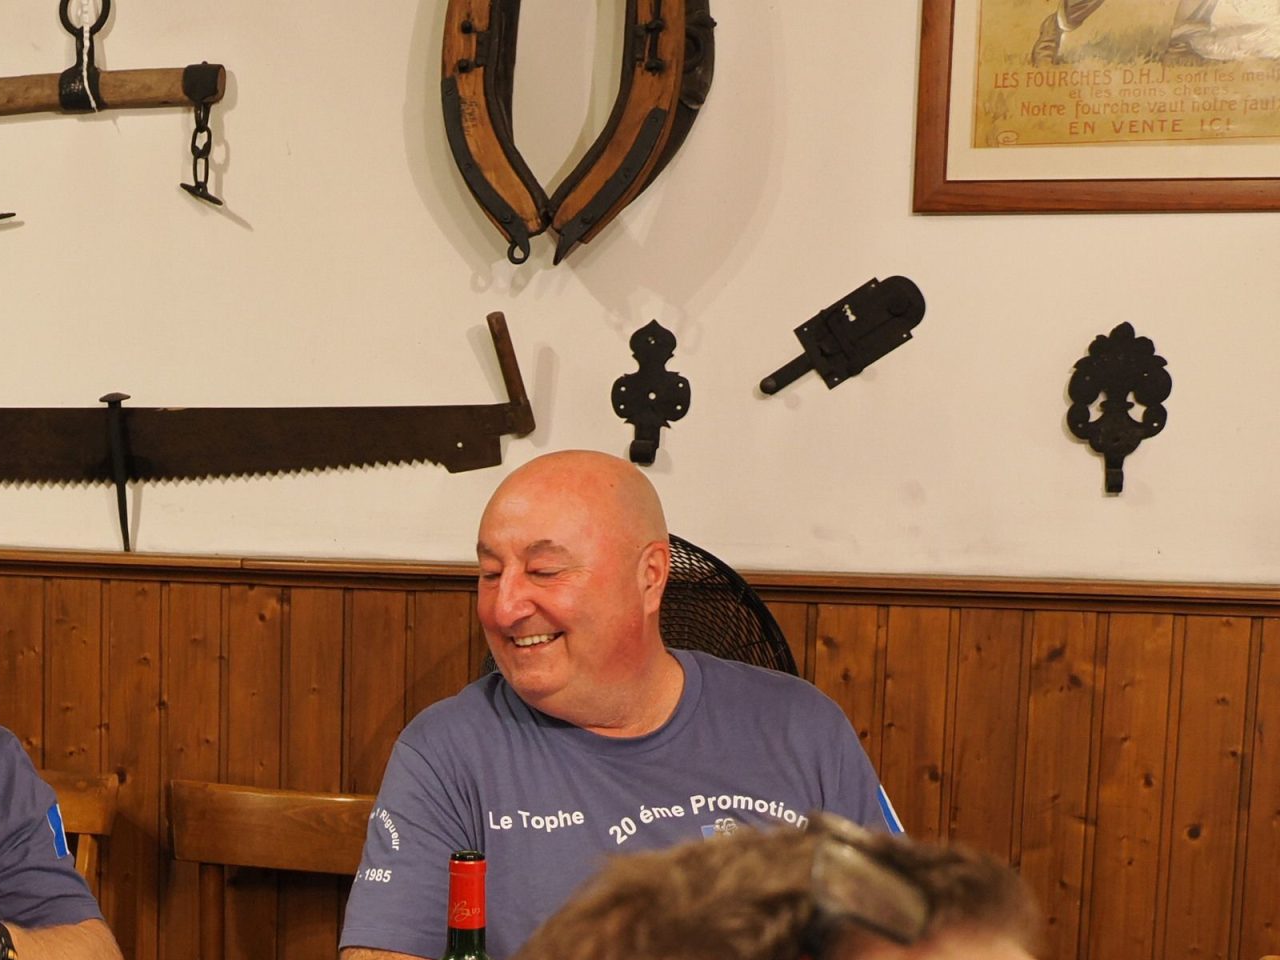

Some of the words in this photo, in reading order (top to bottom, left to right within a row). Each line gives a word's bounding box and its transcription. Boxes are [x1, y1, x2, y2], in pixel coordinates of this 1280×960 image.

[994, 72, 1019, 89] LES
[1025, 70, 1112, 88] FOURCHES
[1176, 71, 1209, 83] sont
[1214, 70, 1234, 82] les
[1020, 101, 1066, 117] Notre
[1074, 98, 1141, 119] fourche
[1147, 99, 1184, 113] vaut
[1191, 97, 1237, 113] notre
[1069, 121, 1096, 135] EN
[1111, 118, 1183, 134] VENTE
[380, 809, 400, 851] Rigueur
[488, 811, 513, 830] Le
[517, 810, 585, 833] Tophe
[608, 817, 637, 845] 20
[639, 805, 685, 824] éme
[690, 794, 809, 832] Promotion
[364, 868, 392, 883] 1985
